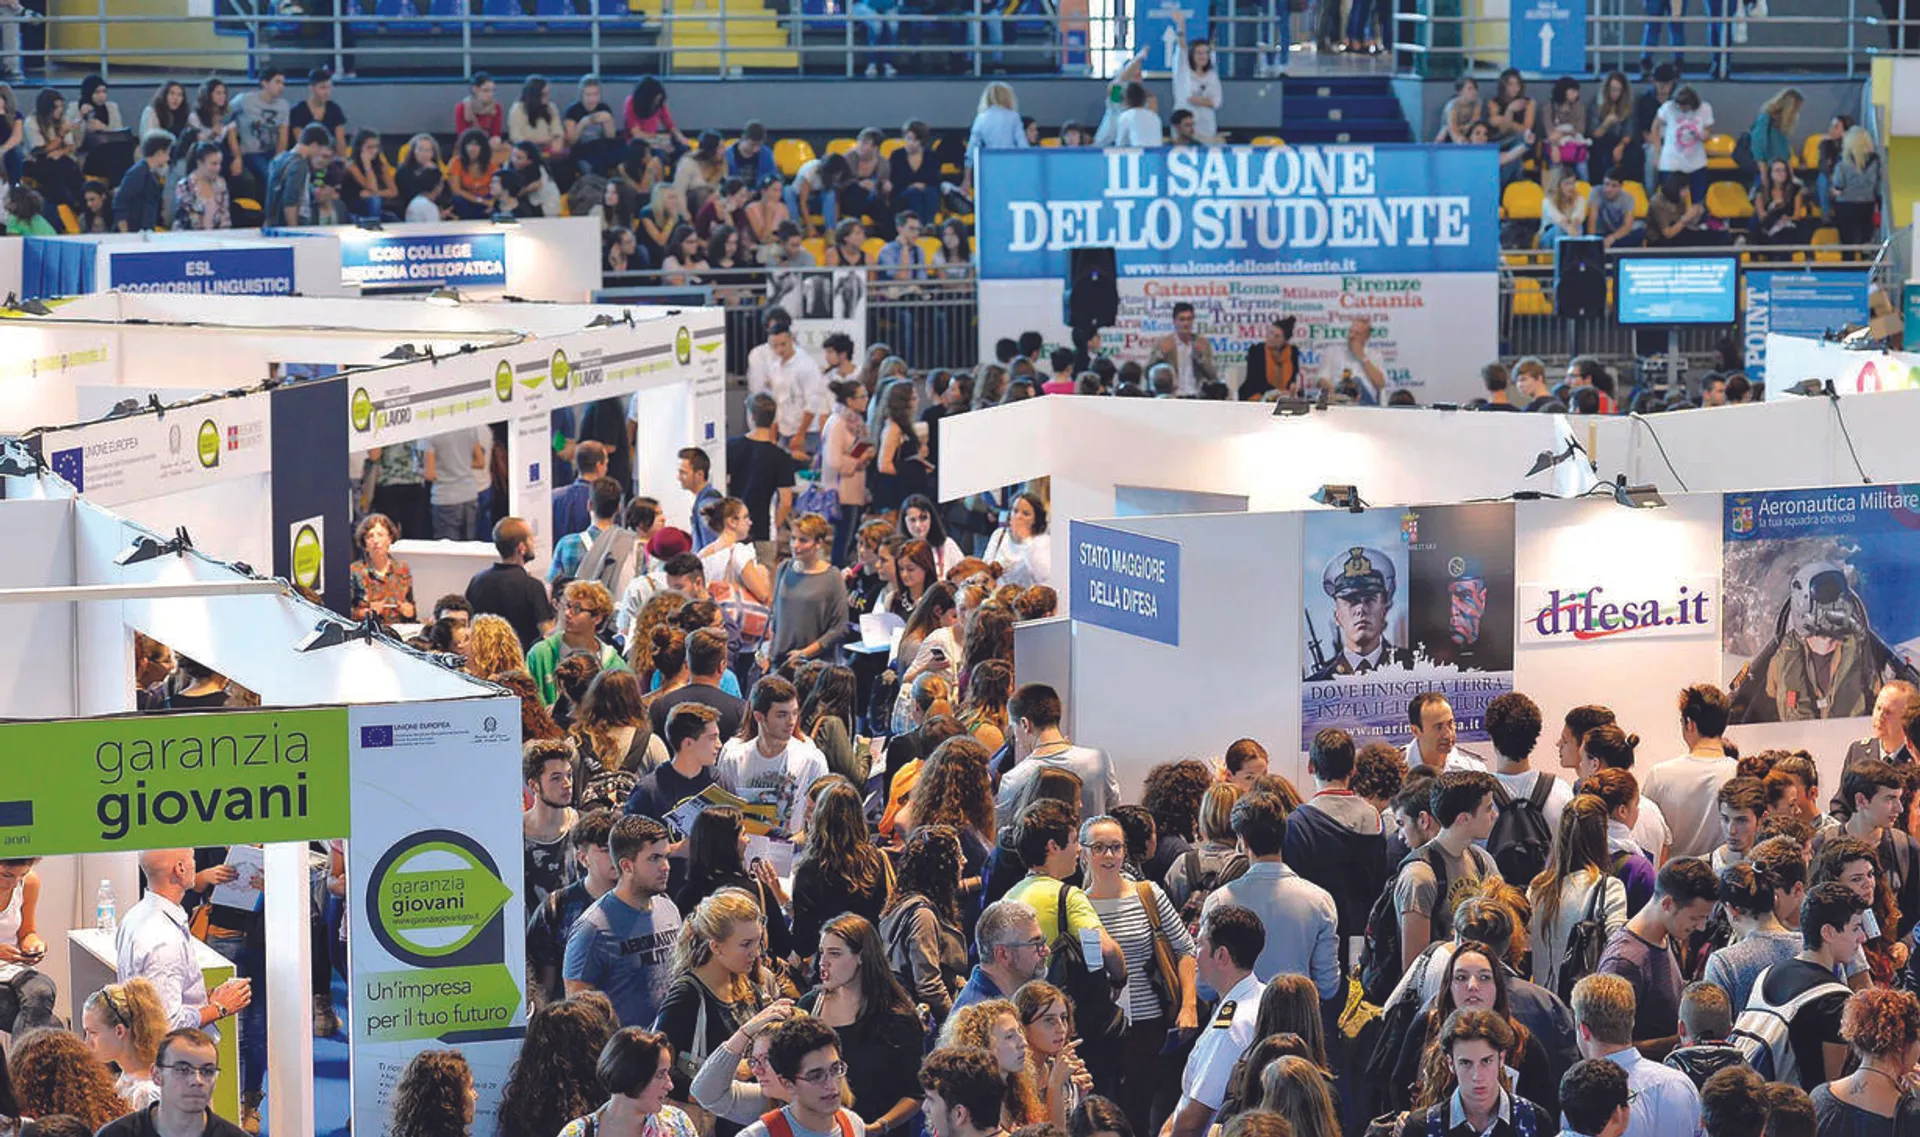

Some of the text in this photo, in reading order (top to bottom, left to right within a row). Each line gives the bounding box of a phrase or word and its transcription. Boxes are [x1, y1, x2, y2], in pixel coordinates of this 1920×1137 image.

[1103, 145, 1376, 198] IL SALONE
[1008, 196, 1471, 252] DELLO STUDENTE
[407, 243, 472, 260] COLLEGE
[185, 260, 215, 276] ESL
[409, 260, 504, 279] OSTEOPATICA
[1124, 259, 1357, 276] www.salonedellostudente.it
[205, 277, 290, 293] LINGUISTICI
[1143, 276, 1422, 299] Catania Roma Milano Firenze
[1339, 291, 1424, 308] Catania
[1210, 307, 1280, 324] Torino
[1745, 287, 1769, 367] POINT
[1759, 490, 1920, 516] Aeronautica Militare
[1768, 516, 1783, 527] tua
[1784, 513, 1820, 529] squadra
[1820, 513, 1836, 525] che
[1838, 511, 1856, 523] vola
[1079, 541, 1166, 584] STATO MAGGIORE
[1090, 579, 1158, 619] DELLA DIFESA
[1535, 586, 1710, 636] difesa.it
[1311, 685, 1358, 700] DOVE
[1361, 682, 1423, 697] FINISCE
[1453, 677, 1506, 693] TERRA
[1317, 702, 1370, 718] INIZIA
[394, 721, 451, 731] UNIONE EUROPEA
[95, 722, 310, 785] garanzia
[96, 771, 308, 840] giovani
[3, 831, 31, 846] anni
[391, 875, 465, 898] garanzia
[391, 892, 465, 917] giovani
[366, 980, 472, 1003] Un'impresa
[366, 1003, 508, 1037] per il tuo futuro
